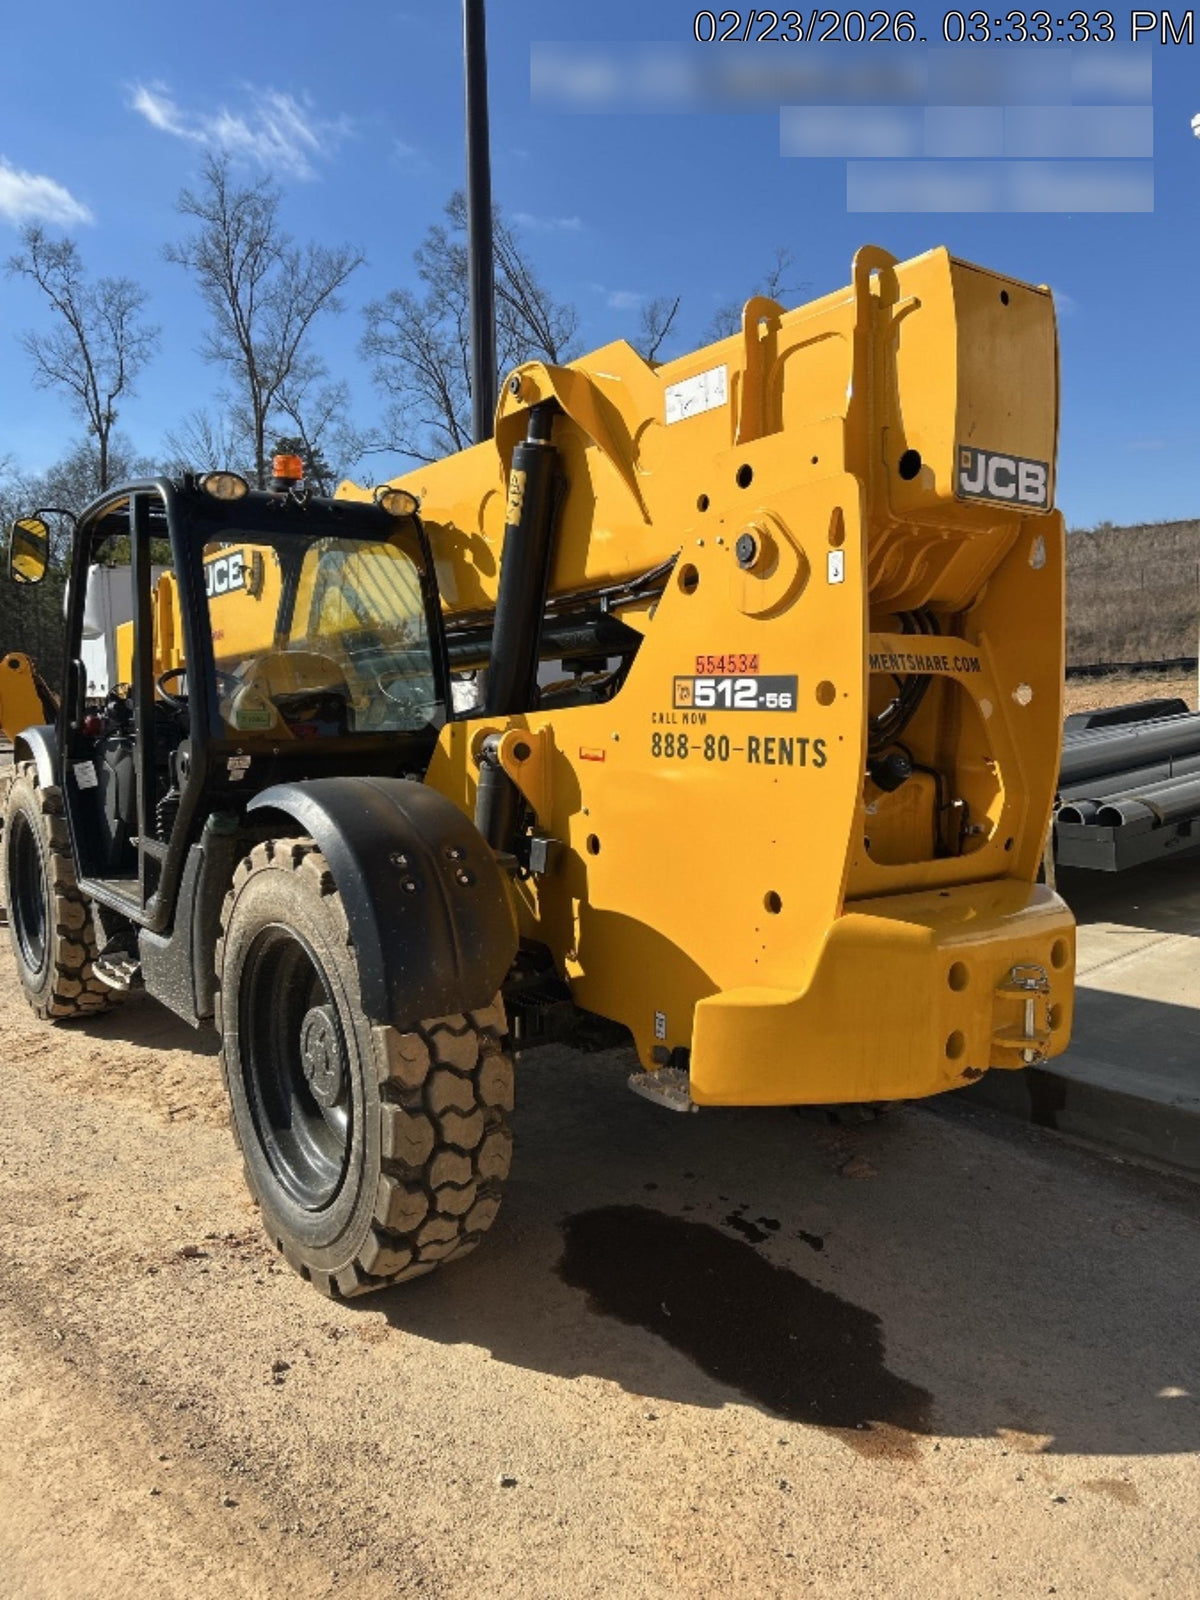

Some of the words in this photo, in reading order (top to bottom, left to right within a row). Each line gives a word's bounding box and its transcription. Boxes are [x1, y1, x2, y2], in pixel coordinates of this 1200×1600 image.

[960, 452, 1046, 503] JCB
[204, 554, 244, 597] JCB
[696, 654, 759, 674] 554534
[694, 678, 792, 708] 512-56
[652, 713, 678, 724] CALL
[683, 713, 707, 725] NOW
[651, 732, 828, 768] 888-80-RENTS
